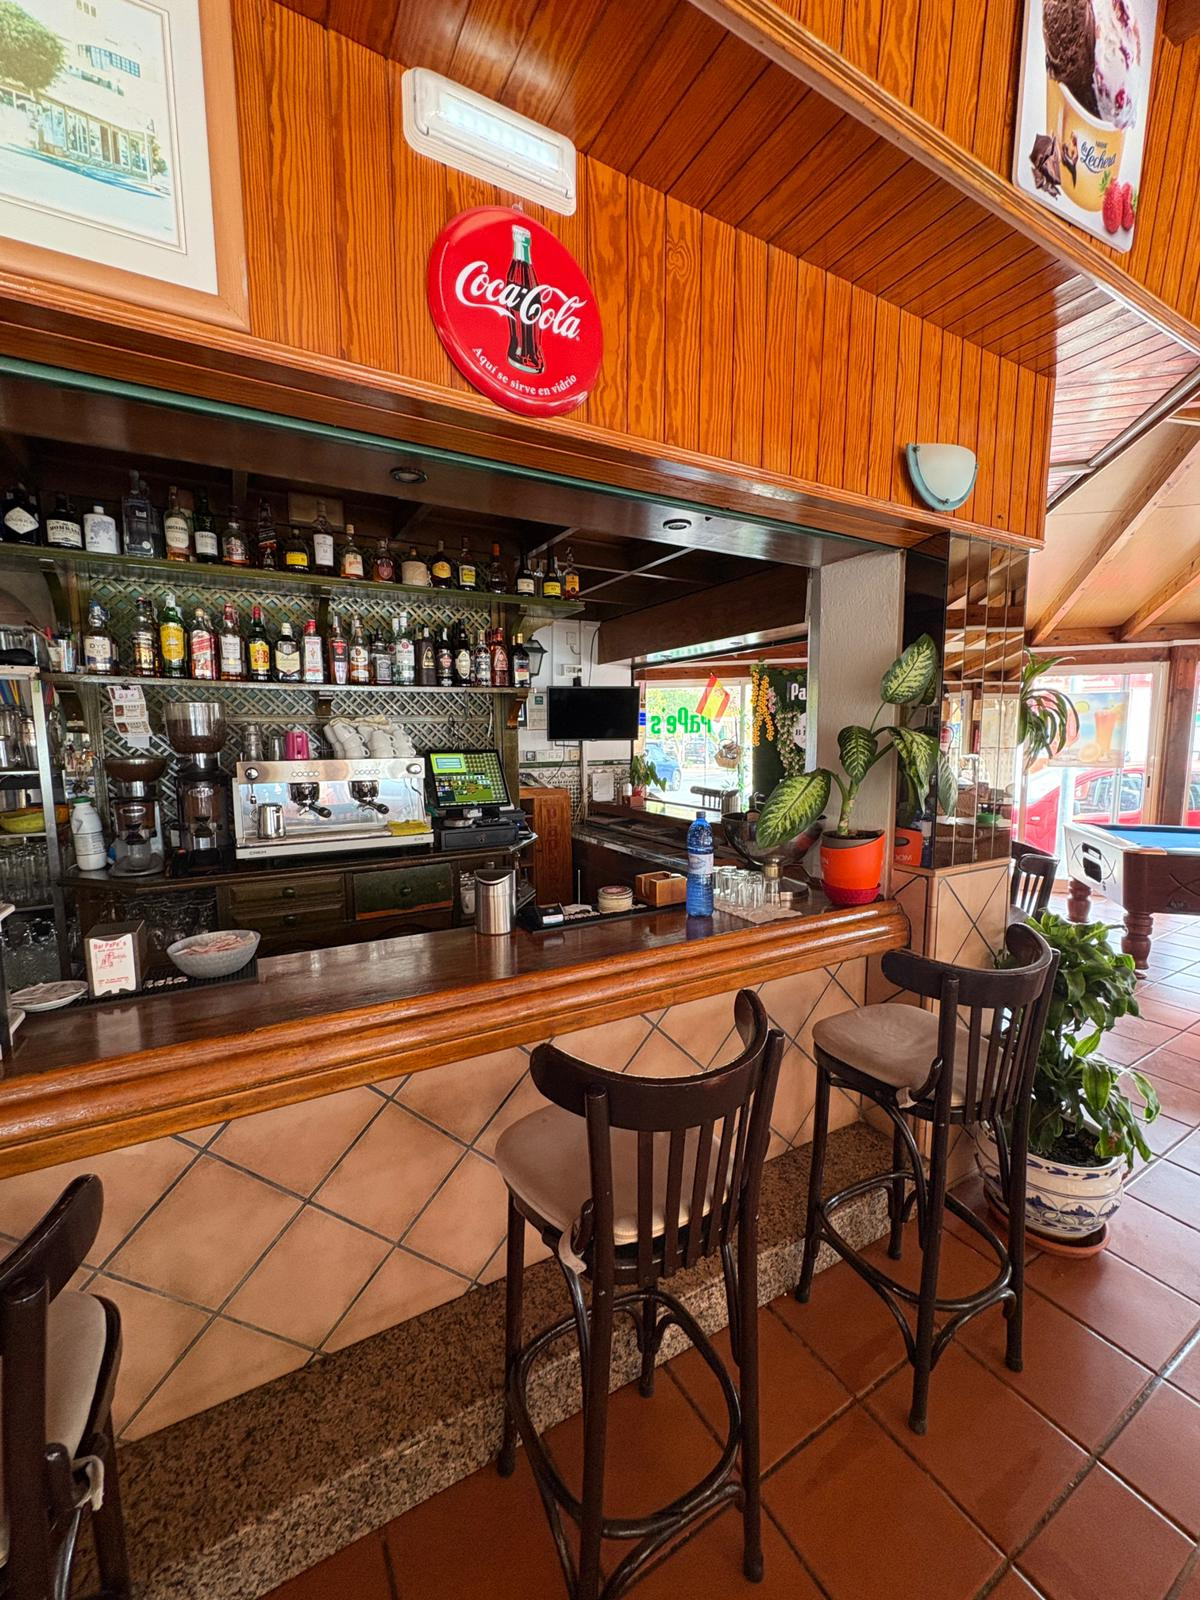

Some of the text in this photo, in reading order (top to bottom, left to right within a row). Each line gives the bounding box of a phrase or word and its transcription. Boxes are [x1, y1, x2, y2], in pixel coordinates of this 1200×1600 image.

[455, 260, 588, 339] Coca-Cola
[496, 369, 509, 384] se
[510, 379, 537, 396] sirve
[537, 384, 551, 396] en
[550, 373, 577, 395] vidrio
